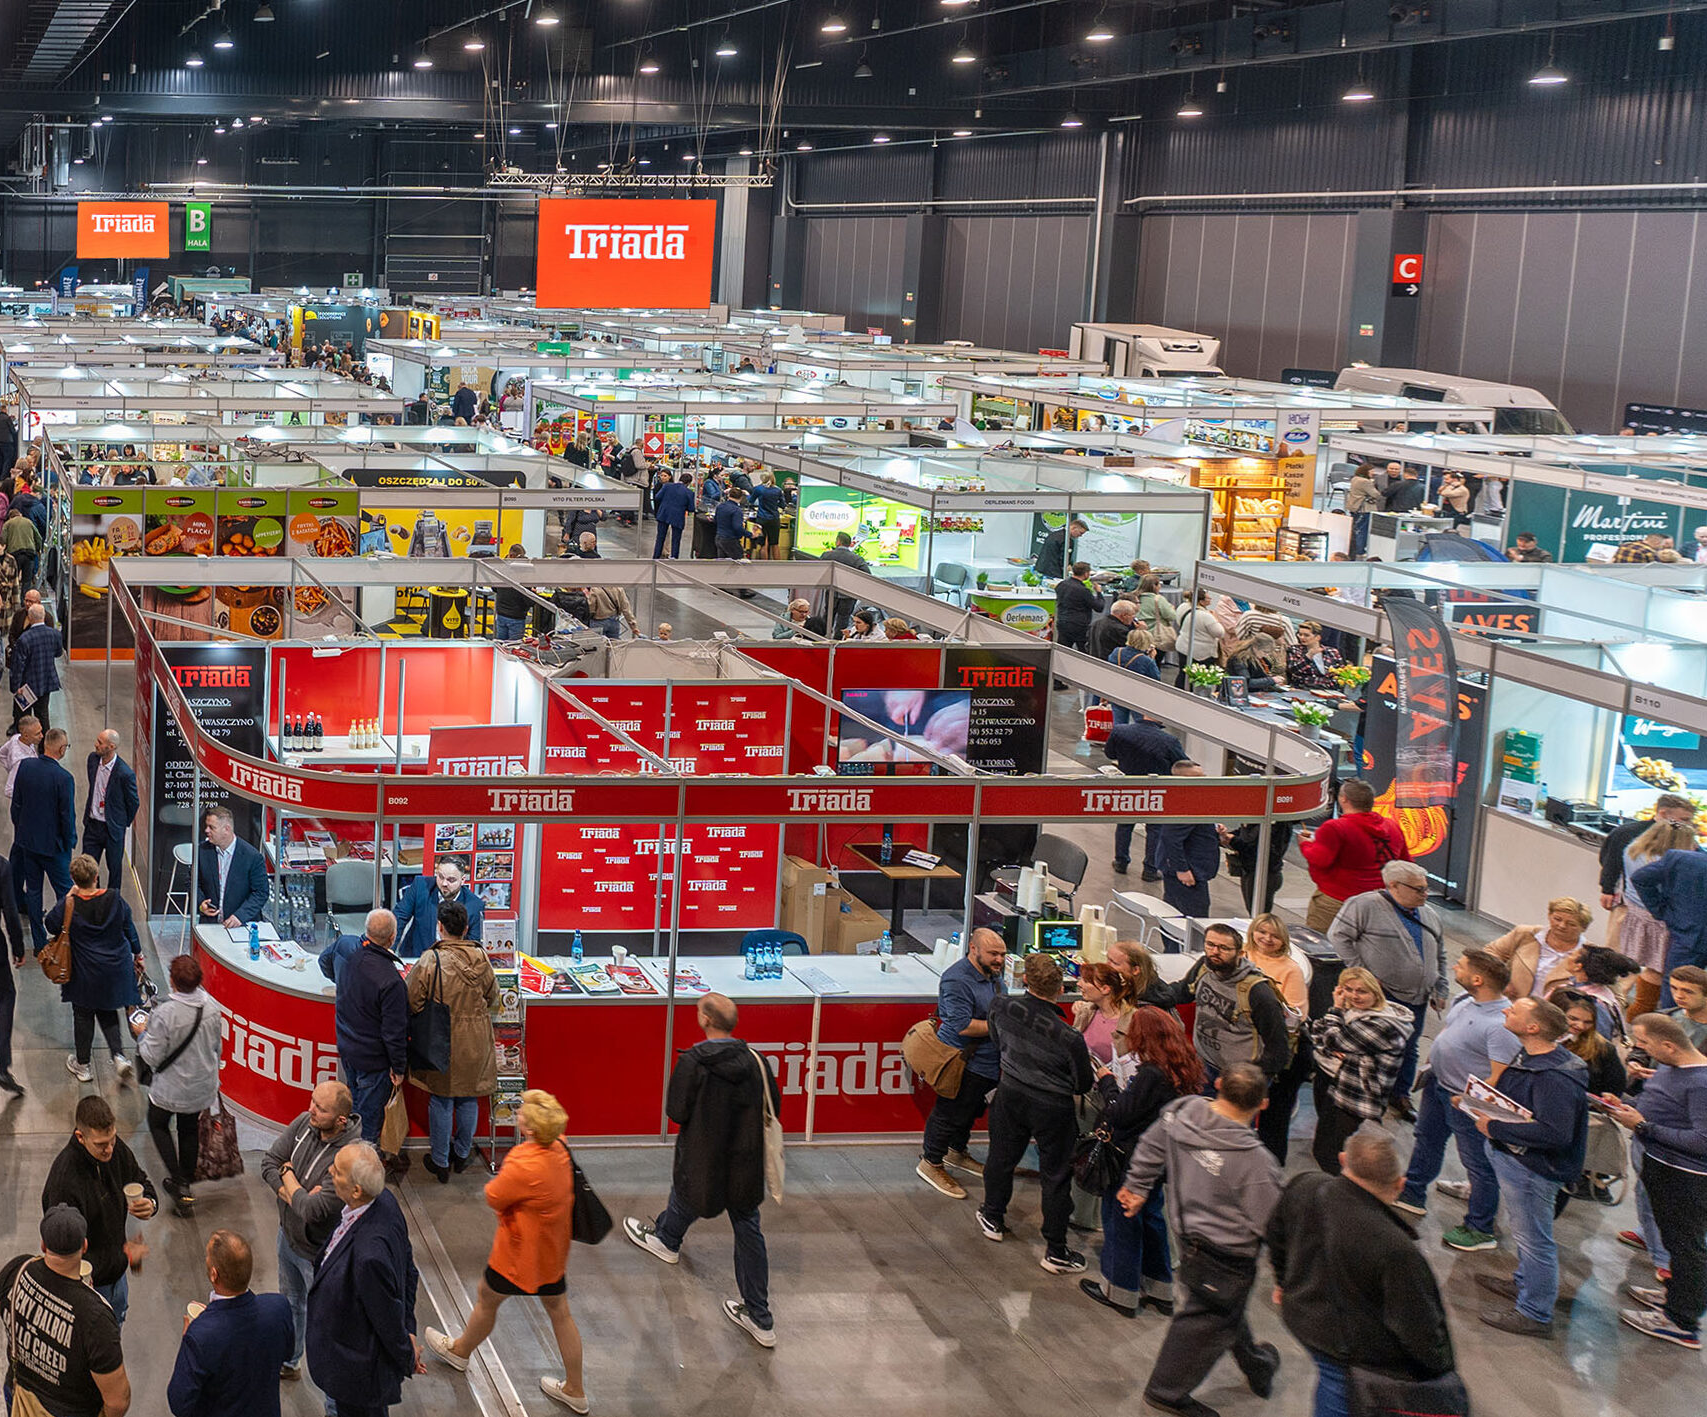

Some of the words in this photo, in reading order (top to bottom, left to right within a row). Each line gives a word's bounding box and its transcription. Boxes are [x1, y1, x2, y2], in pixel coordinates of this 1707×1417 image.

[92, 214, 156, 232] Triada
[190, 209, 206, 232] B
[565, 224, 689, 260] Triada
[1399, 258, 1416, 278] C
[378, 477, 445, 487] OSZCZĘDZAJ
[448, 477, 463, 486] DO
[809, 510, 850, 521] Oerlemans
[1572, 504, 1668, 532] Martini
[187, 527, 211, 535] PLACKI
[1200, 572, 1215, 581] B113
[1283, 596, 1300, 606] AVES
[1006, 612, 1044, 624] Oerlemans
[1458, 613, 1530, 635] AVES
[171, 666, 252, 687] Triada
[958, 667, 1036, 687] Triada
[187, 698, 231, 706] ASZCZYNO:
[1635, 695, 1660, 708] B110
[696, 720, 736, 731] Triada
[546, 746, 587, 757] Triada
[744, 746, 784, 757] Triada
[228, 759, 304, 803] Triada
[388, 797, 408, 805] B092
[488, 789, 575, 812] Triada
[788, 789, 873, 812] Triada
[1082, 789, 1167, 812] Triada
[580, 828, 621, 839] Triada
[706, 827, 746, 838] Triada
[594, 881, 634, 892] Triada
[688, 880, 727, 891] Triada
[219, 1005, 340, 1092] iada
[748, 1042, 914, 1096] riada
[33, 1305, 74, 1349] BALBOA
[33, 1337, 67, 1373] CREED
